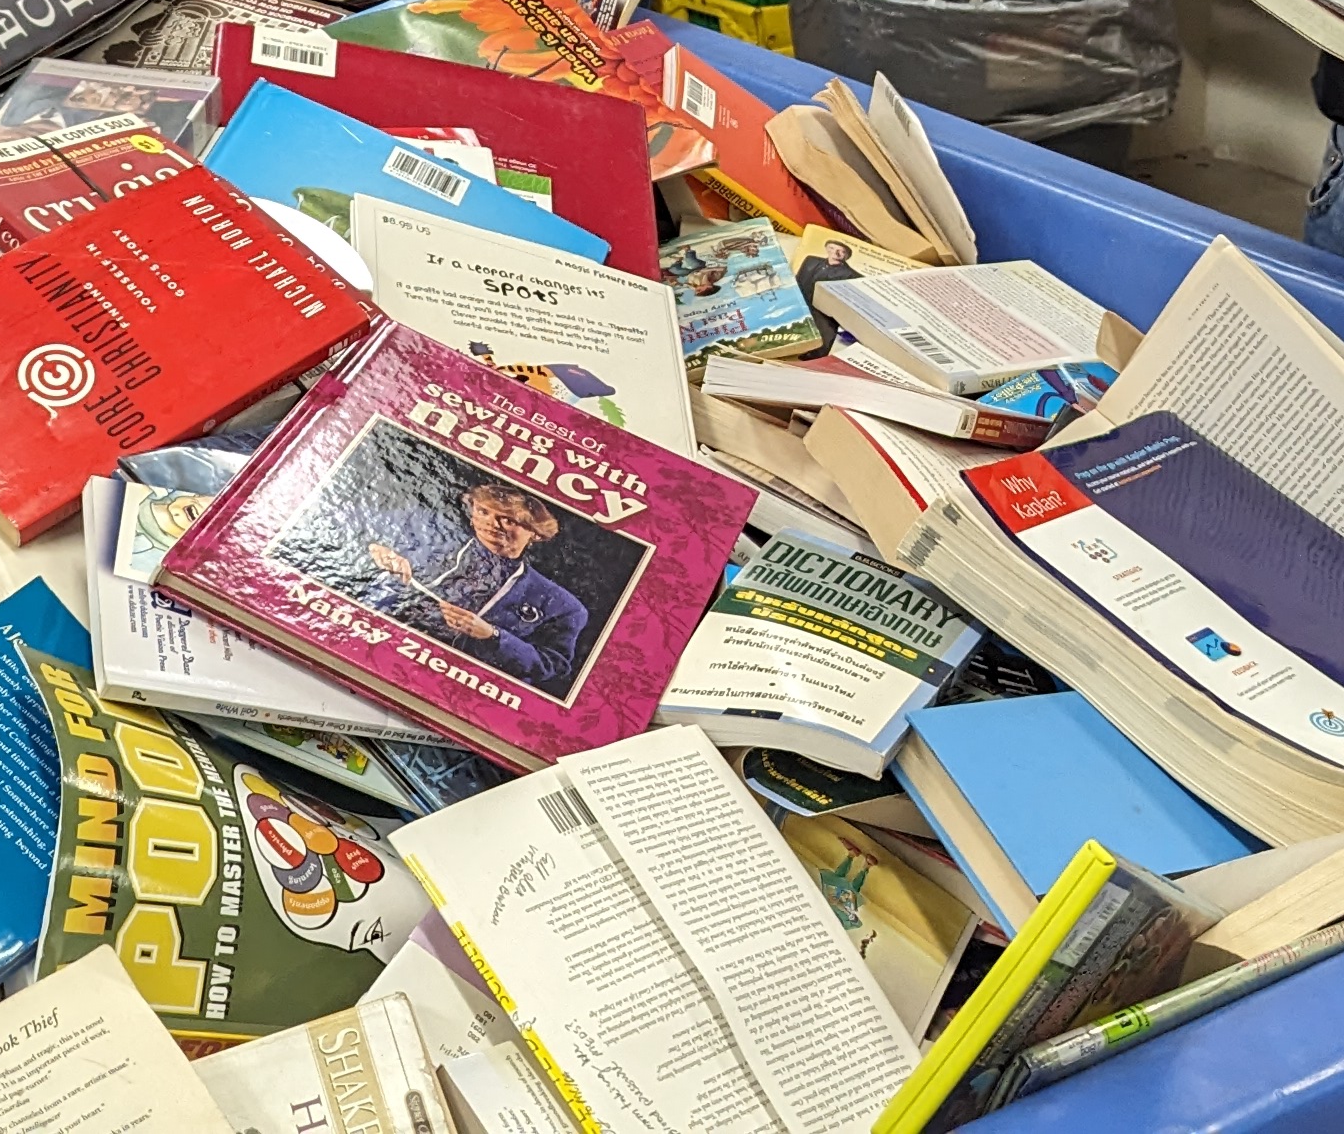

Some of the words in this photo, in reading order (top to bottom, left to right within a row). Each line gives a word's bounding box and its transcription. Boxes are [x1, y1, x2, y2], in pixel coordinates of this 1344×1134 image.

[526, 0, 562, 27] ant?
[527, 14, 546, 33] an
[560, 27, 579, 44] an
[575, 45, 604, 66] not
[13, 130, 61, 155] MILLON
[63, 124, 106, 145] COPIES
[108, 117, 136, 136] SOLD
[37, 158, 54, 171] by
[182, 194, 254, 250] HORTON
[415, 225, 432, 236] US
[85, 242, 102, 259] IN
[111, 229, 150, 262] STORY
[101, 256, 157, 314] YOURSELF
[150, 263, 185, 298] GOD'S
[248, 249, 327, 319] MICHAEL
[426, 253, 444, 266] If
[452, 260, 463, 269] a
[529, 275, 583, 295] changes
[584, 286, 606, 300] its
[12, 253, 162, 393] CHRISTIANITY
[82, 281, 131, 330] FINDING
[759, 333, 802, 343] MAGIC
[83, 385, 157, 450] CORE
[490, 394, 525, 416] The
[531, 412, 576, 440] Best
[581, 435, 607, 452] Of
[423, 382, 555, 454] sewing
[565, 448, 649, 496] with
[406, 399, 648, 524] nancy
[1000, 474, 1038, 496] Why
[1011, 490, 1067, 520] Kaplan?
[761, 540, 962, 629] DICTIONARY
[287, 584, 392, 645] Nancy
[396, 638, 522, 712] Zieman
[40, 662, 107, 742] FOR
[215, 702, 240, 717] White
[214, 784, 236, 818] THE
[15, 838, 48, 870] beyond
[62, 752, 123, 935] MIND
[218, 822, 243, 917] MASTER
[214, 924, 239, 958] TO
[205, 963, 235, 1020] HOW
[19, 1006, 61, 1042] Thief
